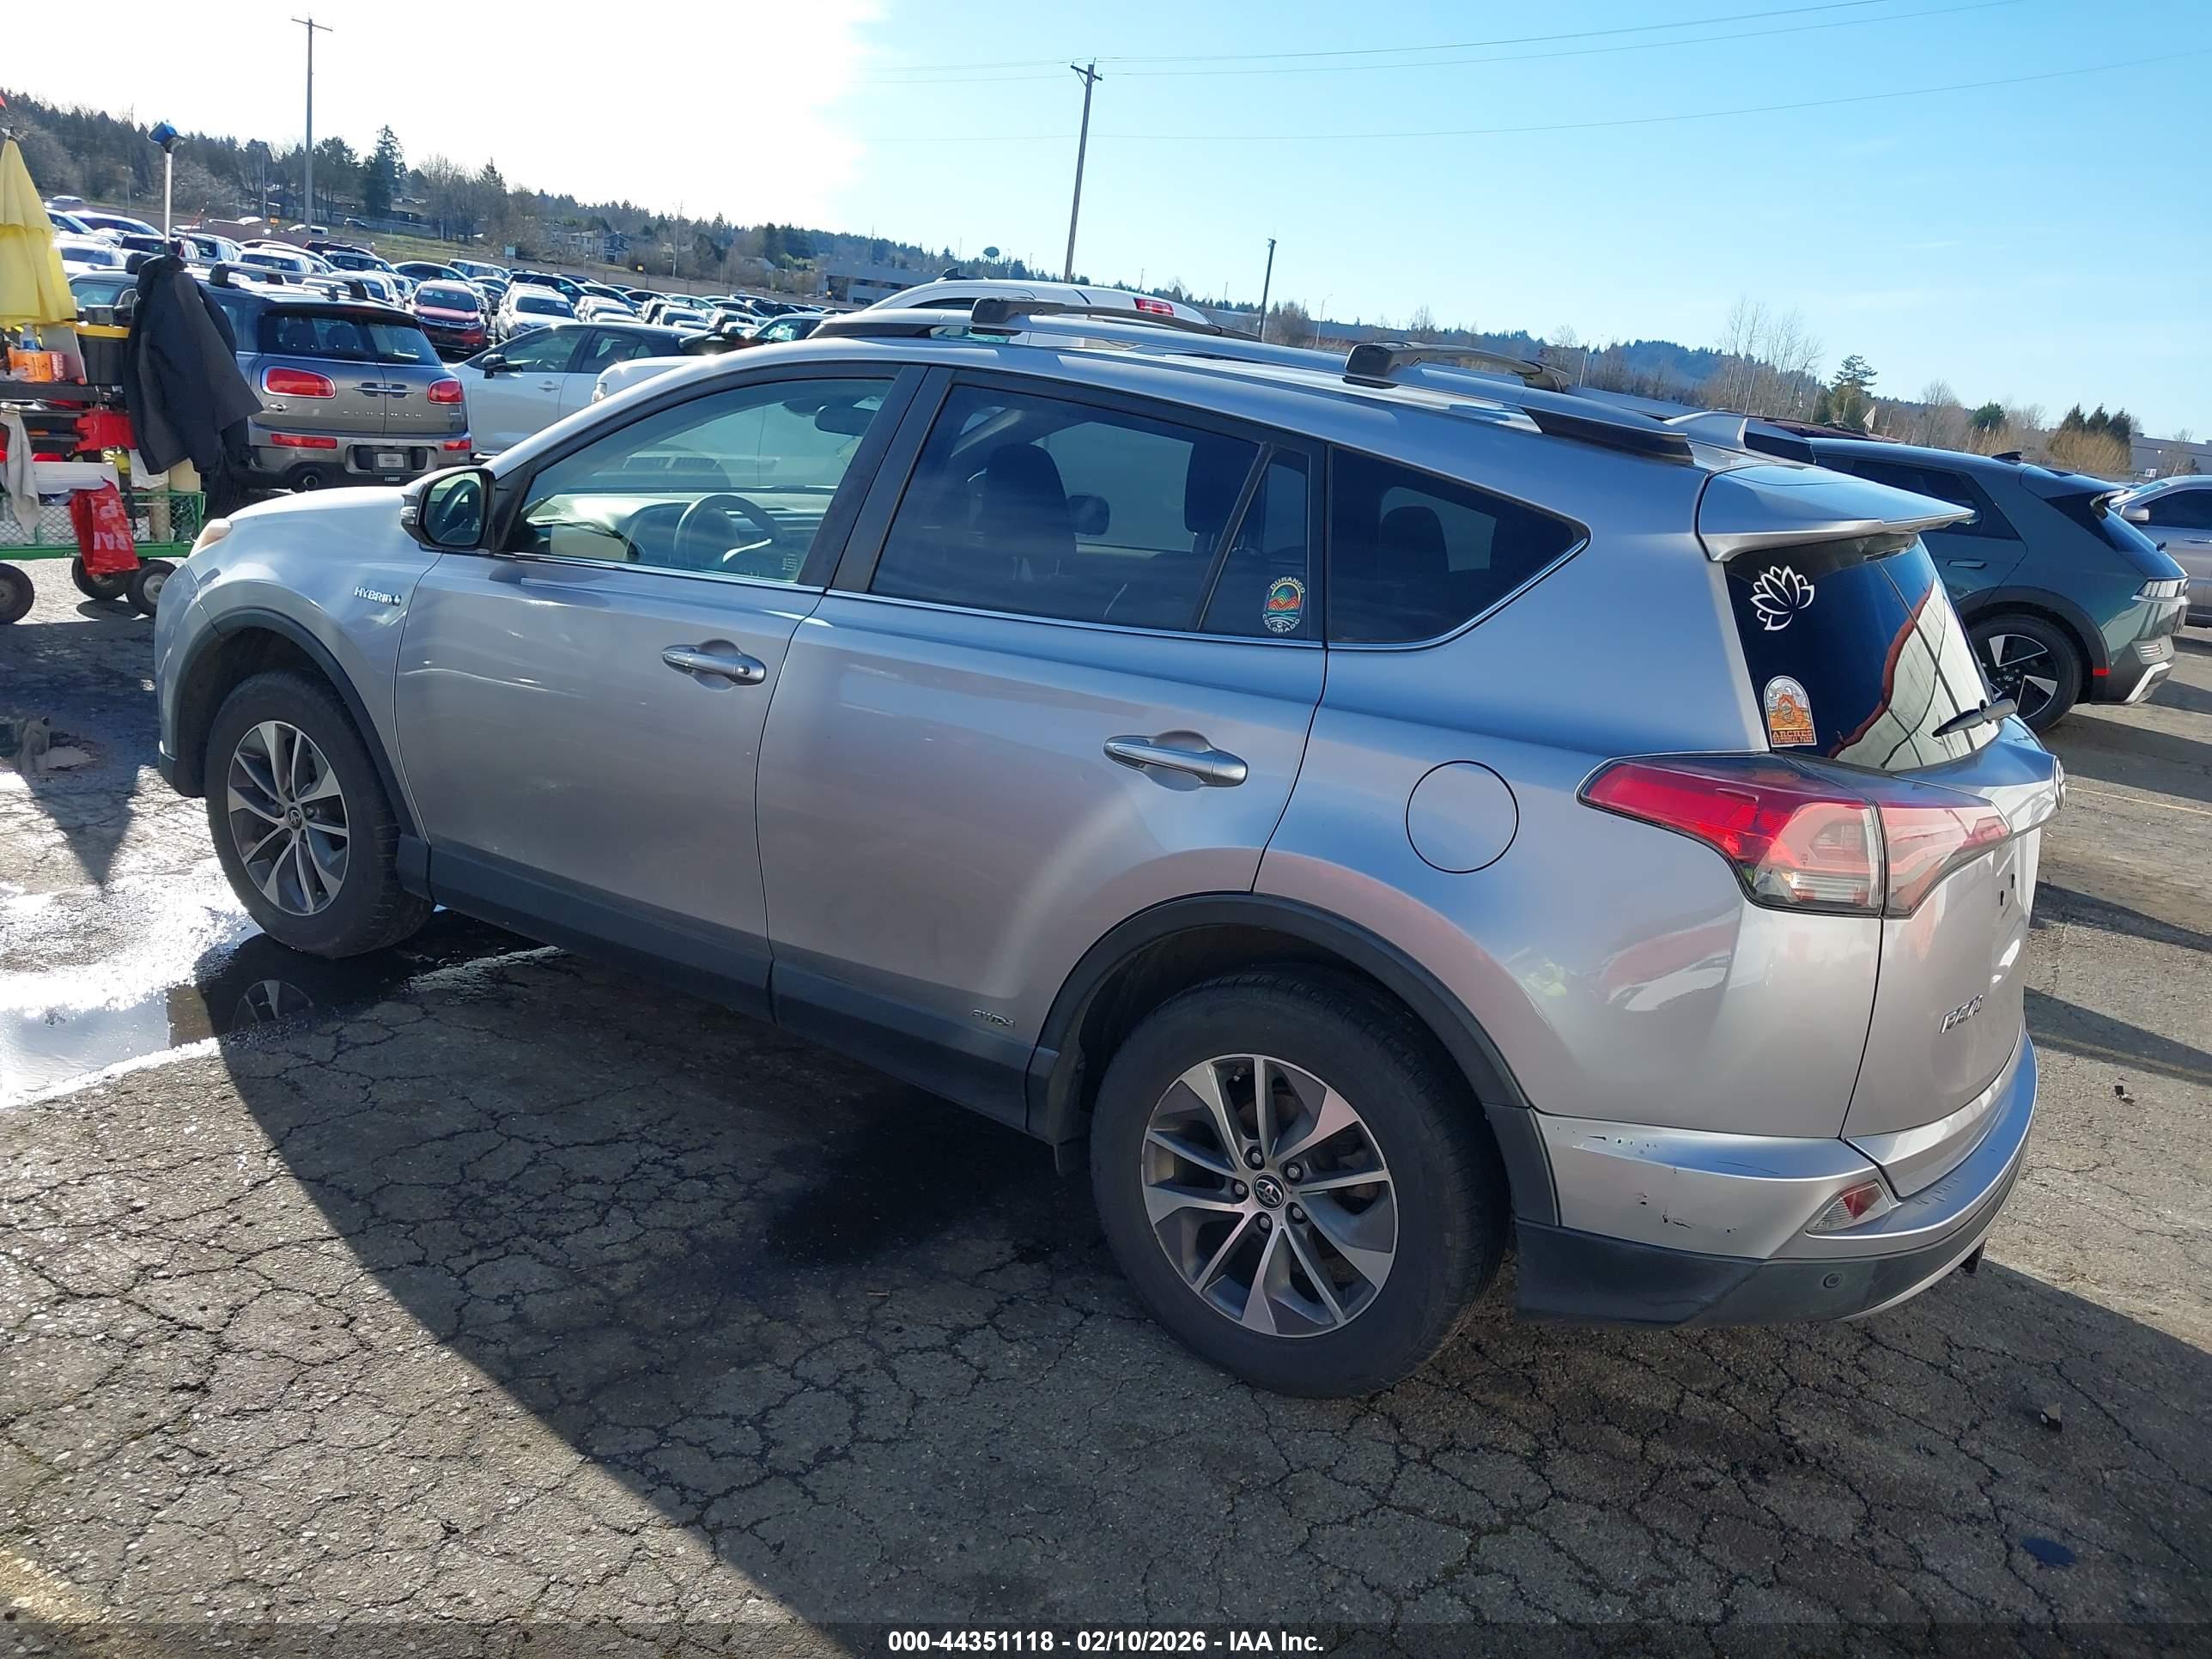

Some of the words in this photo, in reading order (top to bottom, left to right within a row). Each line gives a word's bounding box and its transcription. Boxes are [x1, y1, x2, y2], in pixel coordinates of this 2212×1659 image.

[1270, 576, 1305, 593] DURANGO
[354, 586, 392, 603] HYBRID
[1262, 613, 1300, 633] COLORADO
